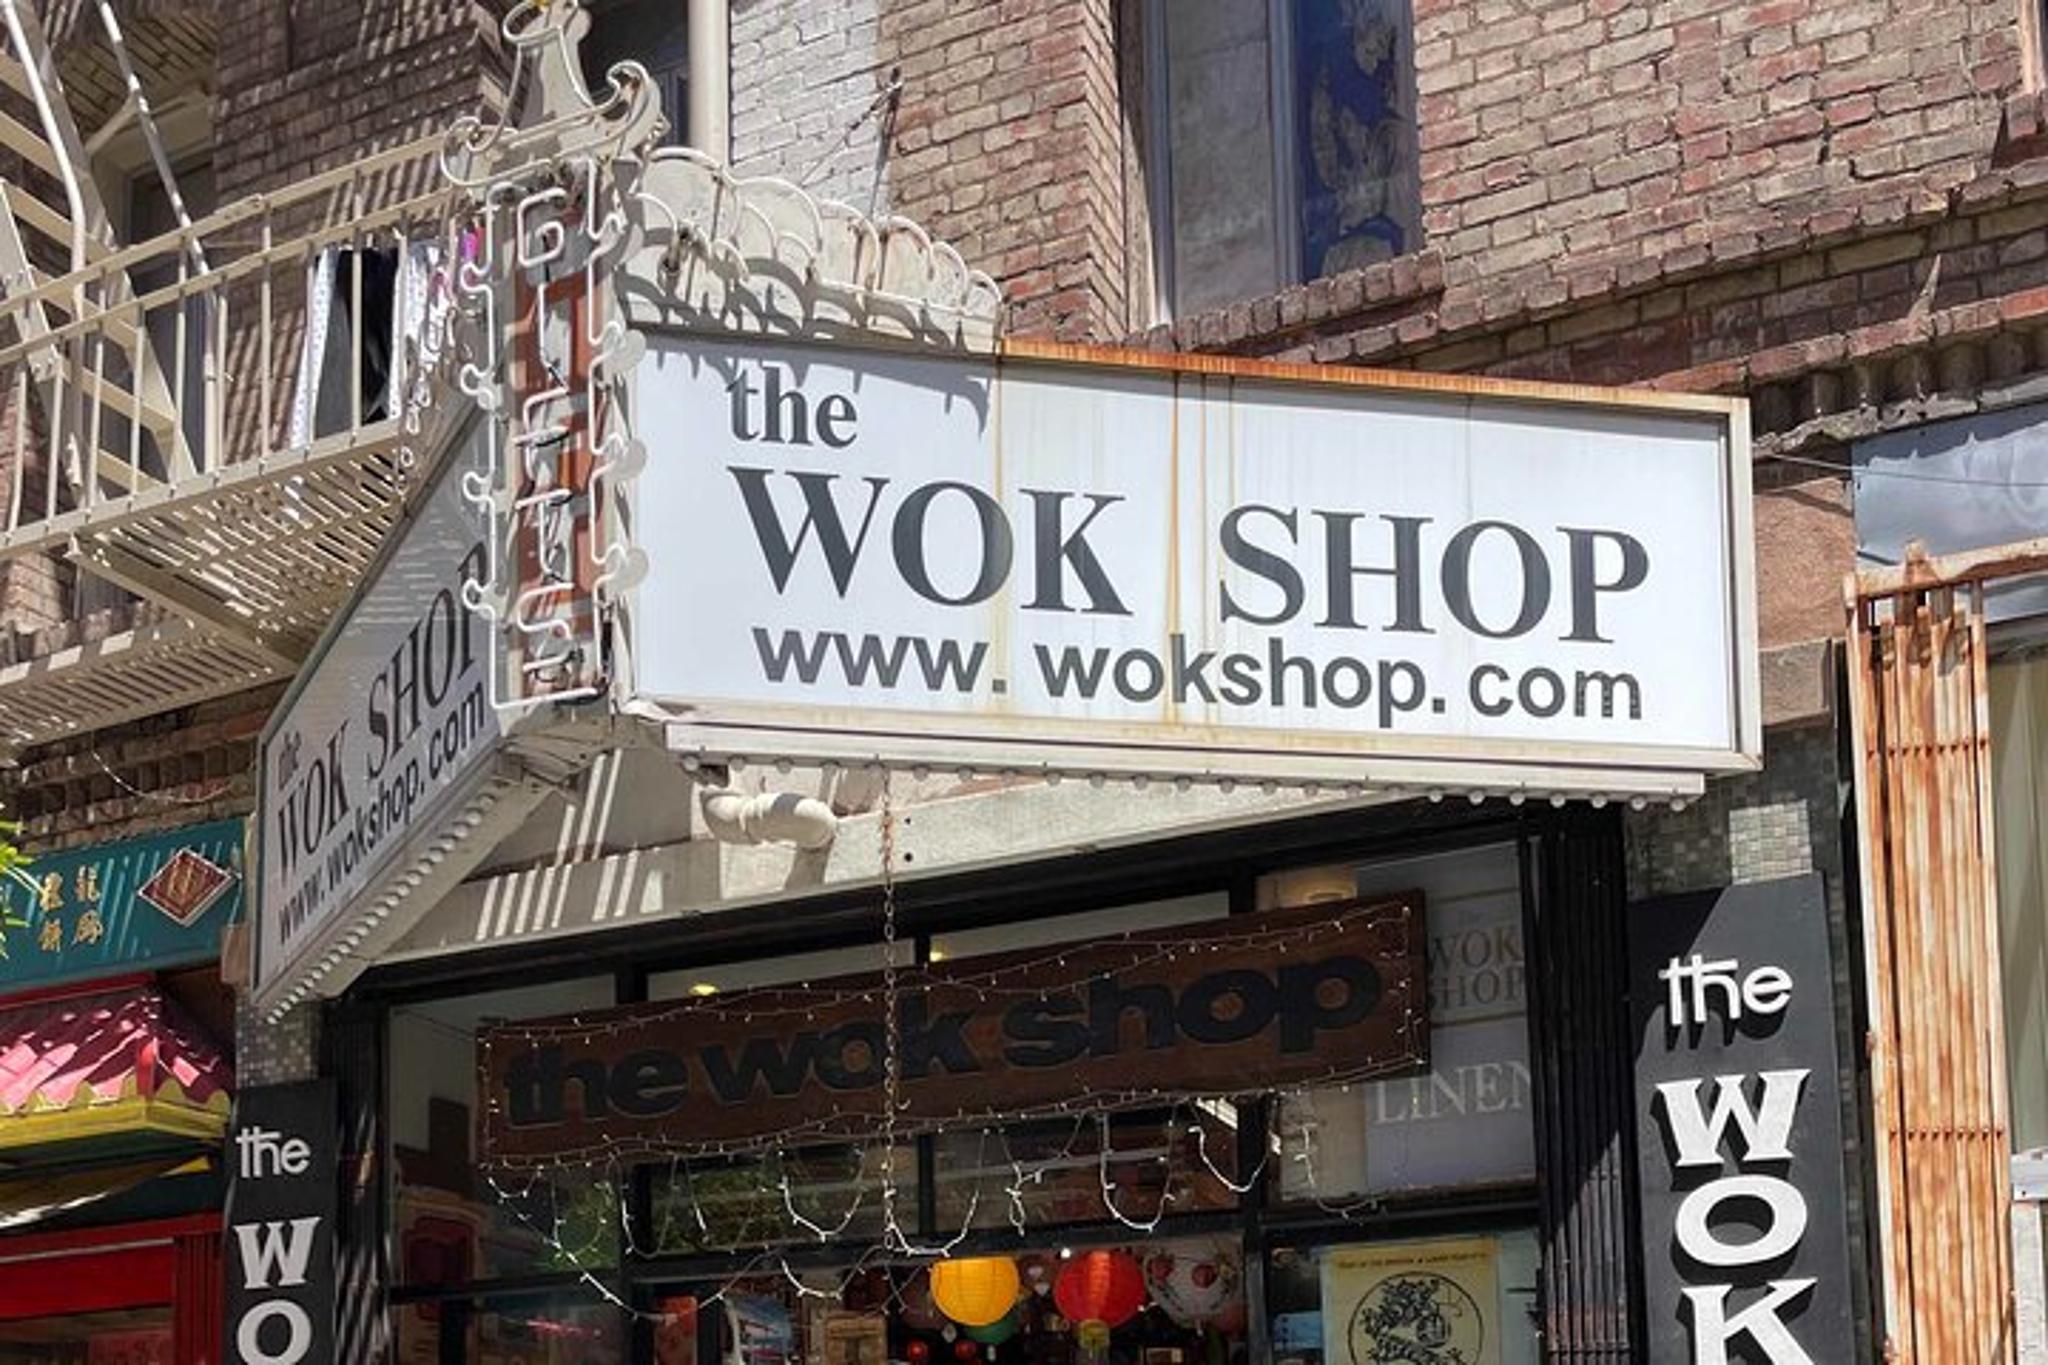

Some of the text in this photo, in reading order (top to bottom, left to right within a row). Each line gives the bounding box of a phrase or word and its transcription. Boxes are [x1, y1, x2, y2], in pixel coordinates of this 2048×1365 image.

[727, 366, 857, 449] the
[727, 466, 1648, 643] WOK SHOP
[278, 540, 487, 889] WOK SHOP
[752, 627, 1642, 728] www. wokshop. com
[278, 730, 302, 791] the
[429, 681, 485, 780] com
[1658, 954, 1794, 1026] the
[507, 954, 1383, 1128] the wok shop
[235, 1126, 311, 1178] the
[1656, 1068, 1818, 1365] WOK
